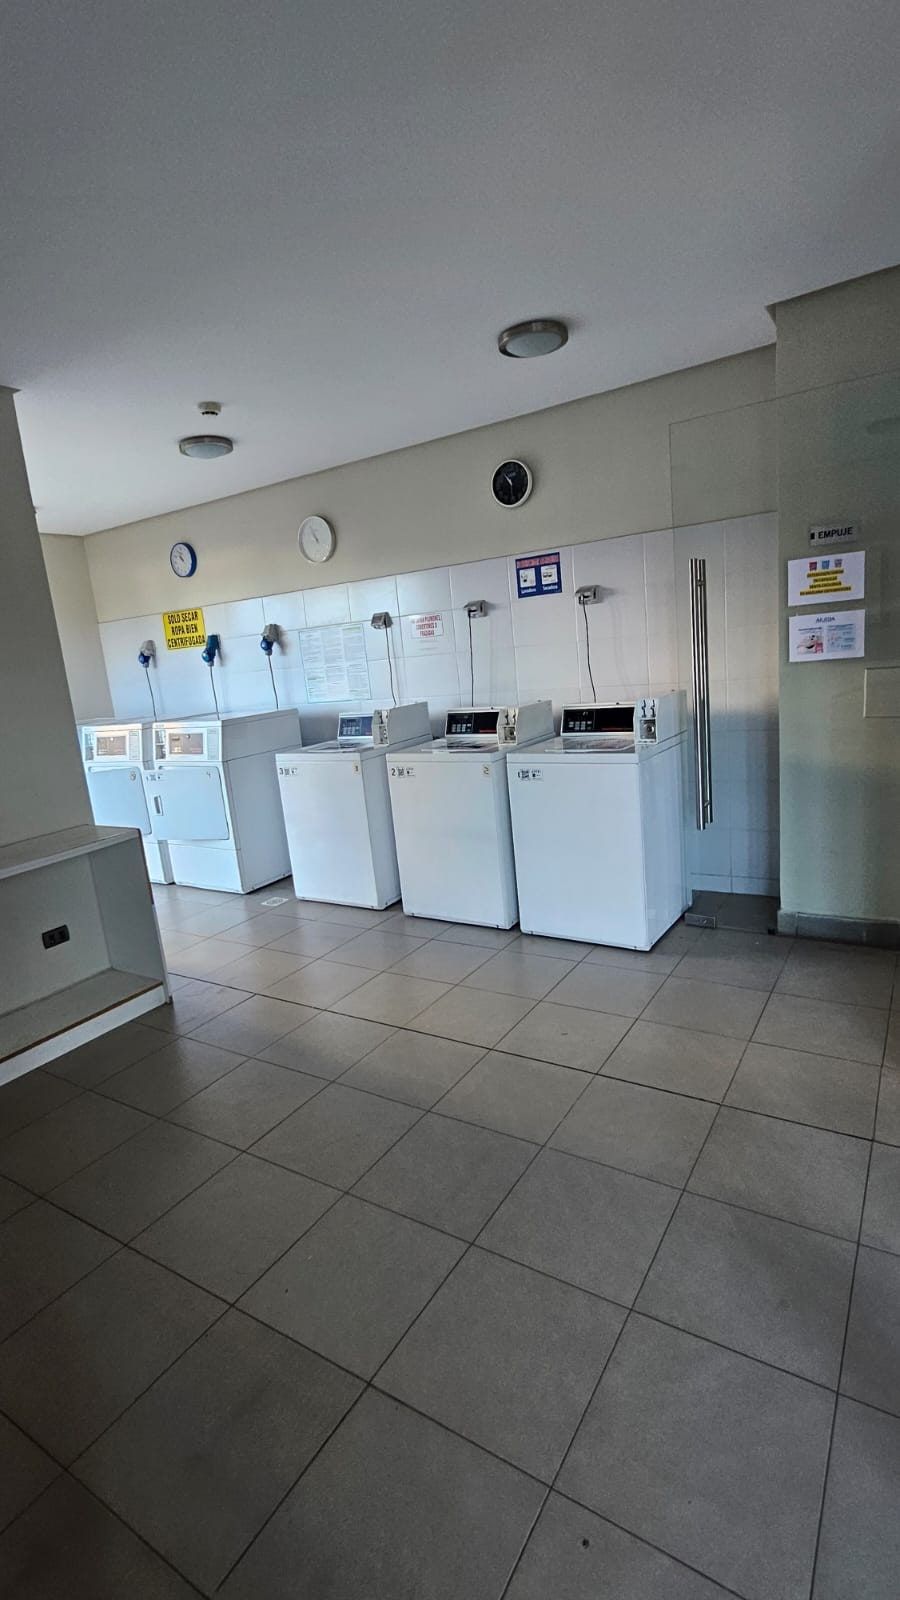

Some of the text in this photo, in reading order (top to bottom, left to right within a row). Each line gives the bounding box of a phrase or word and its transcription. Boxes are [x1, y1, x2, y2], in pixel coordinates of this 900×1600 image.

[818, 527, 853, 539] EMPUJE
[168, 611, 198, 624] SOLO SECAR
[171, 624, 198, 635] ROPA BIEN
[168, 635, 205, 647] CENTRIFUGADA
